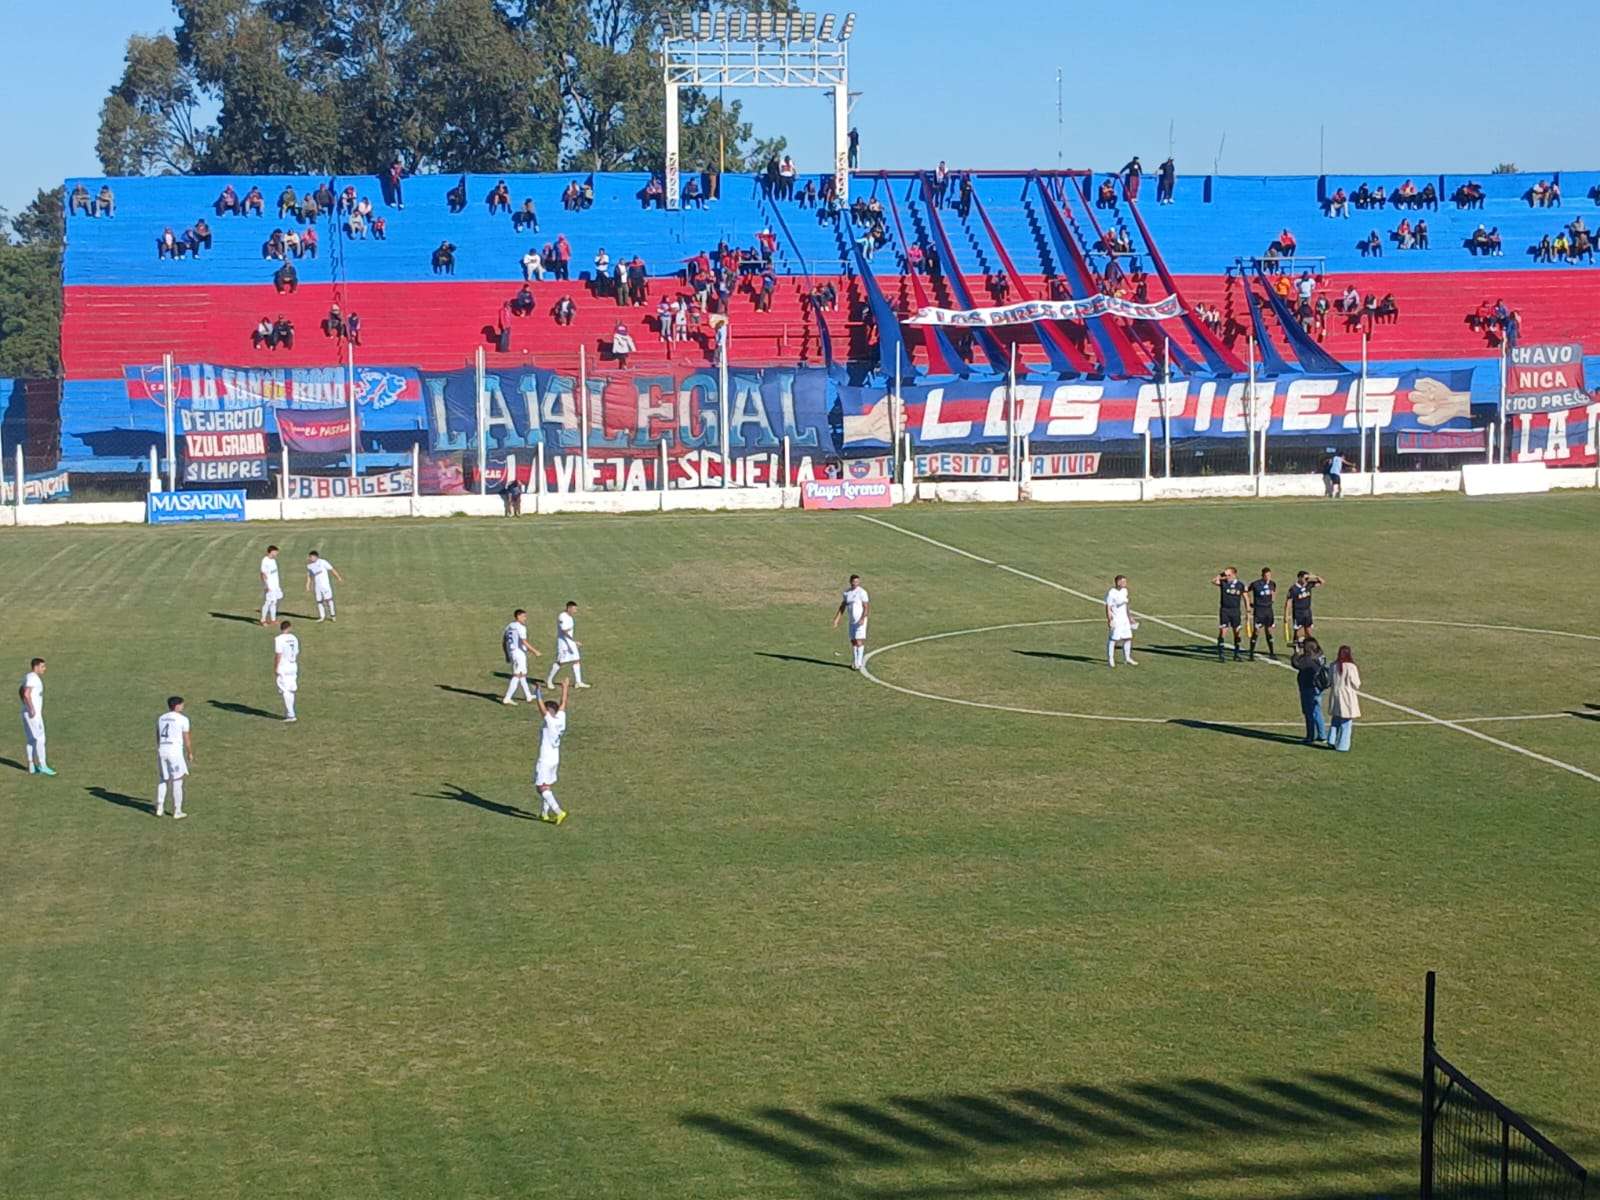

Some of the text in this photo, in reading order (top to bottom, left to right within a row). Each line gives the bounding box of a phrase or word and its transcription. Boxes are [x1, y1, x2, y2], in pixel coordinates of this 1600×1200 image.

[1511, 346, 1573, 364] CHAVO
[1520, 371, 1568, 389] NICA
[584, 373, 818, 449] LEGAL
[921, 377, 1400, 441] LOS PIBES
[186, 460, 263, 481] SIEMPRE
[554, 454, 648, 493] VIEJA
[912, 455, 992, 476] ECESITO
[998, 455, 1044, 475] PA
[1051, 454, 1095, 474] VIVIR
[807, 481, 886, 500] Playa Lorenzo
[151, 493, 243, 512] MASARINA
[160, 722, 170, 741] 4
